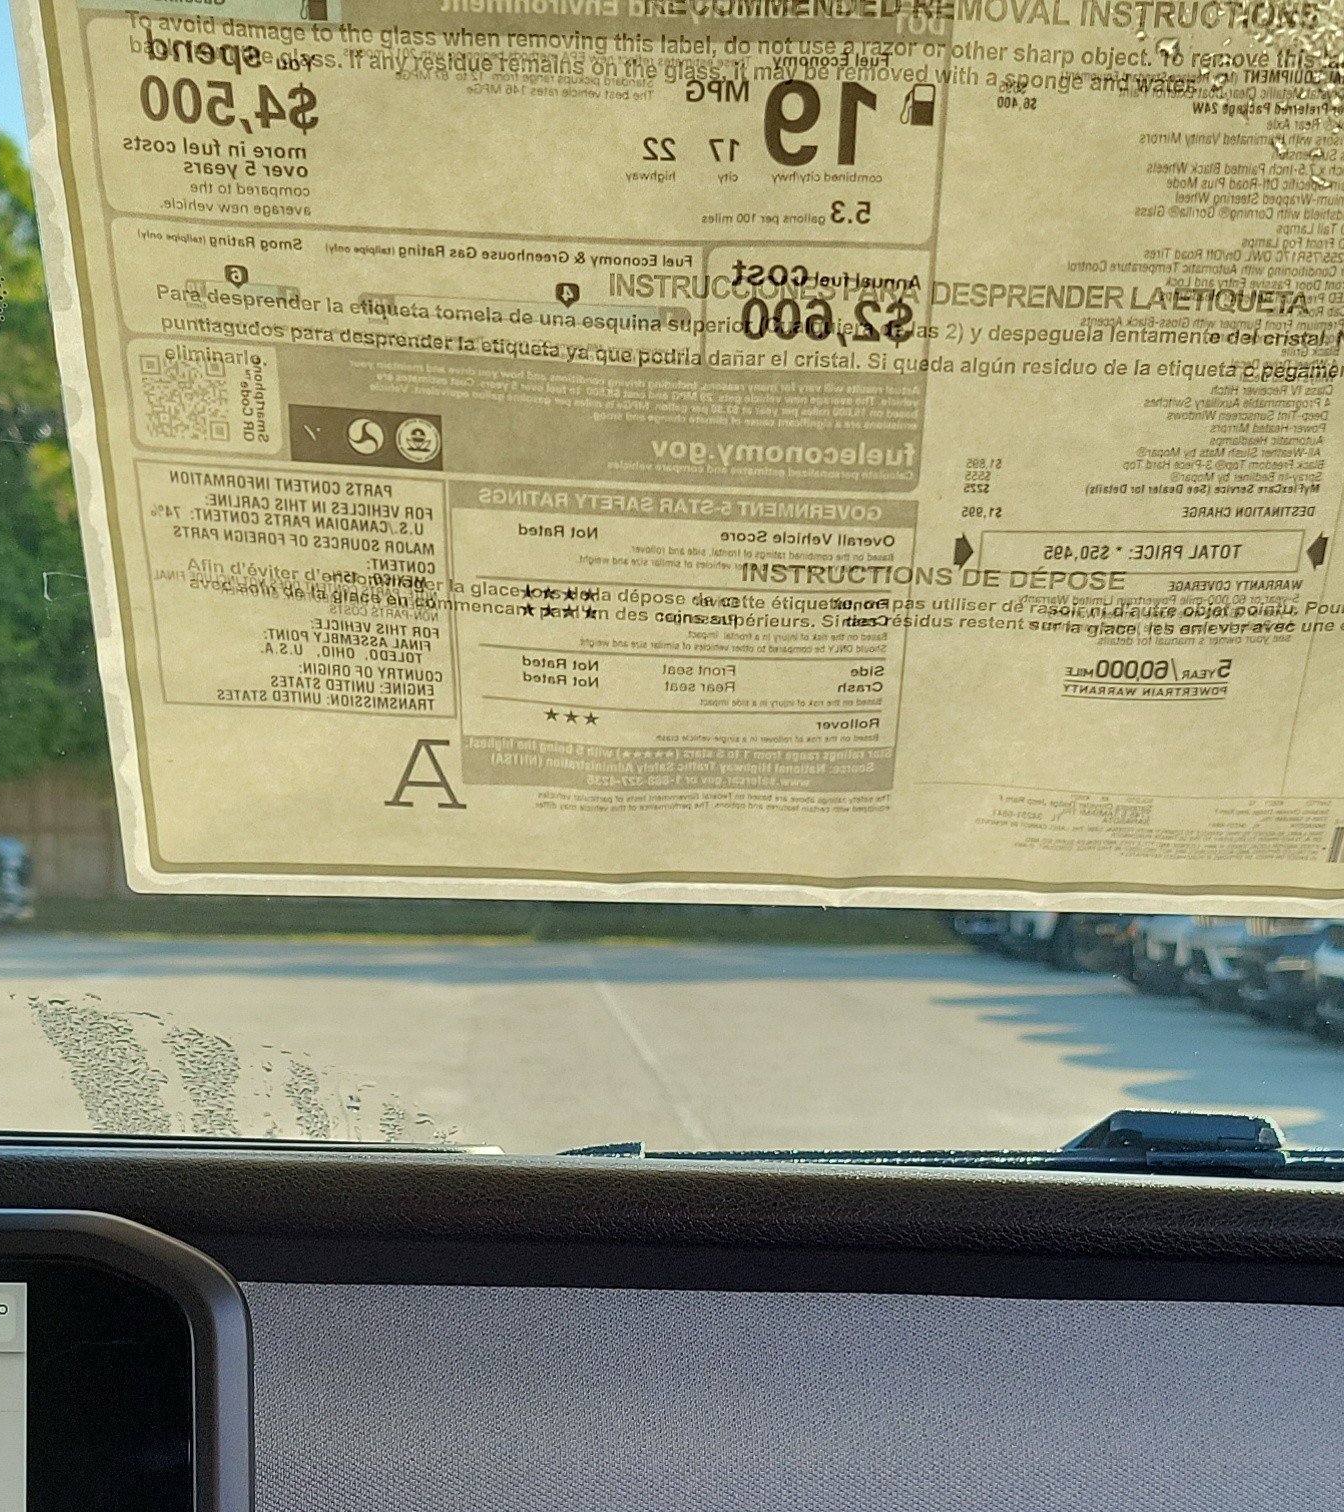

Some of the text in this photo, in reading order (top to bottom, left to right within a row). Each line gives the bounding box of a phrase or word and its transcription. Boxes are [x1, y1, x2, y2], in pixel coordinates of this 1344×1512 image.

[125, 10, 152, 30] To
[158, 14, 215, 34] avoid
[222, 16, 305, 44] damage
[311, 23, 333, 41] to
[340, 23, 373, 43] the
[380, 26, 436, 49] glass
[442, 28, 500, 47] when
[506, 31, 606, 56] removing
[613, 33, 654, 53] this
[661, 35, 716, 56] label,
[724, 36, 751, 55] do
[758, 38, 794, 55] not
[800, 40, 836, 55] use
[861, 40, 917, 57] razor
[922, 43, 946, 58] or
[951, 41, 1008, 61] other
[1013, 42, 1075, 73] sharp
[1081, 45, 1152, 67] object.
[931, 281, 1122, 309] DESPRENDER
[1131, 287, 1166, 310] LA
[740, 563, 1127, 591] INSTRUCTIONS DE DÉPOSE
